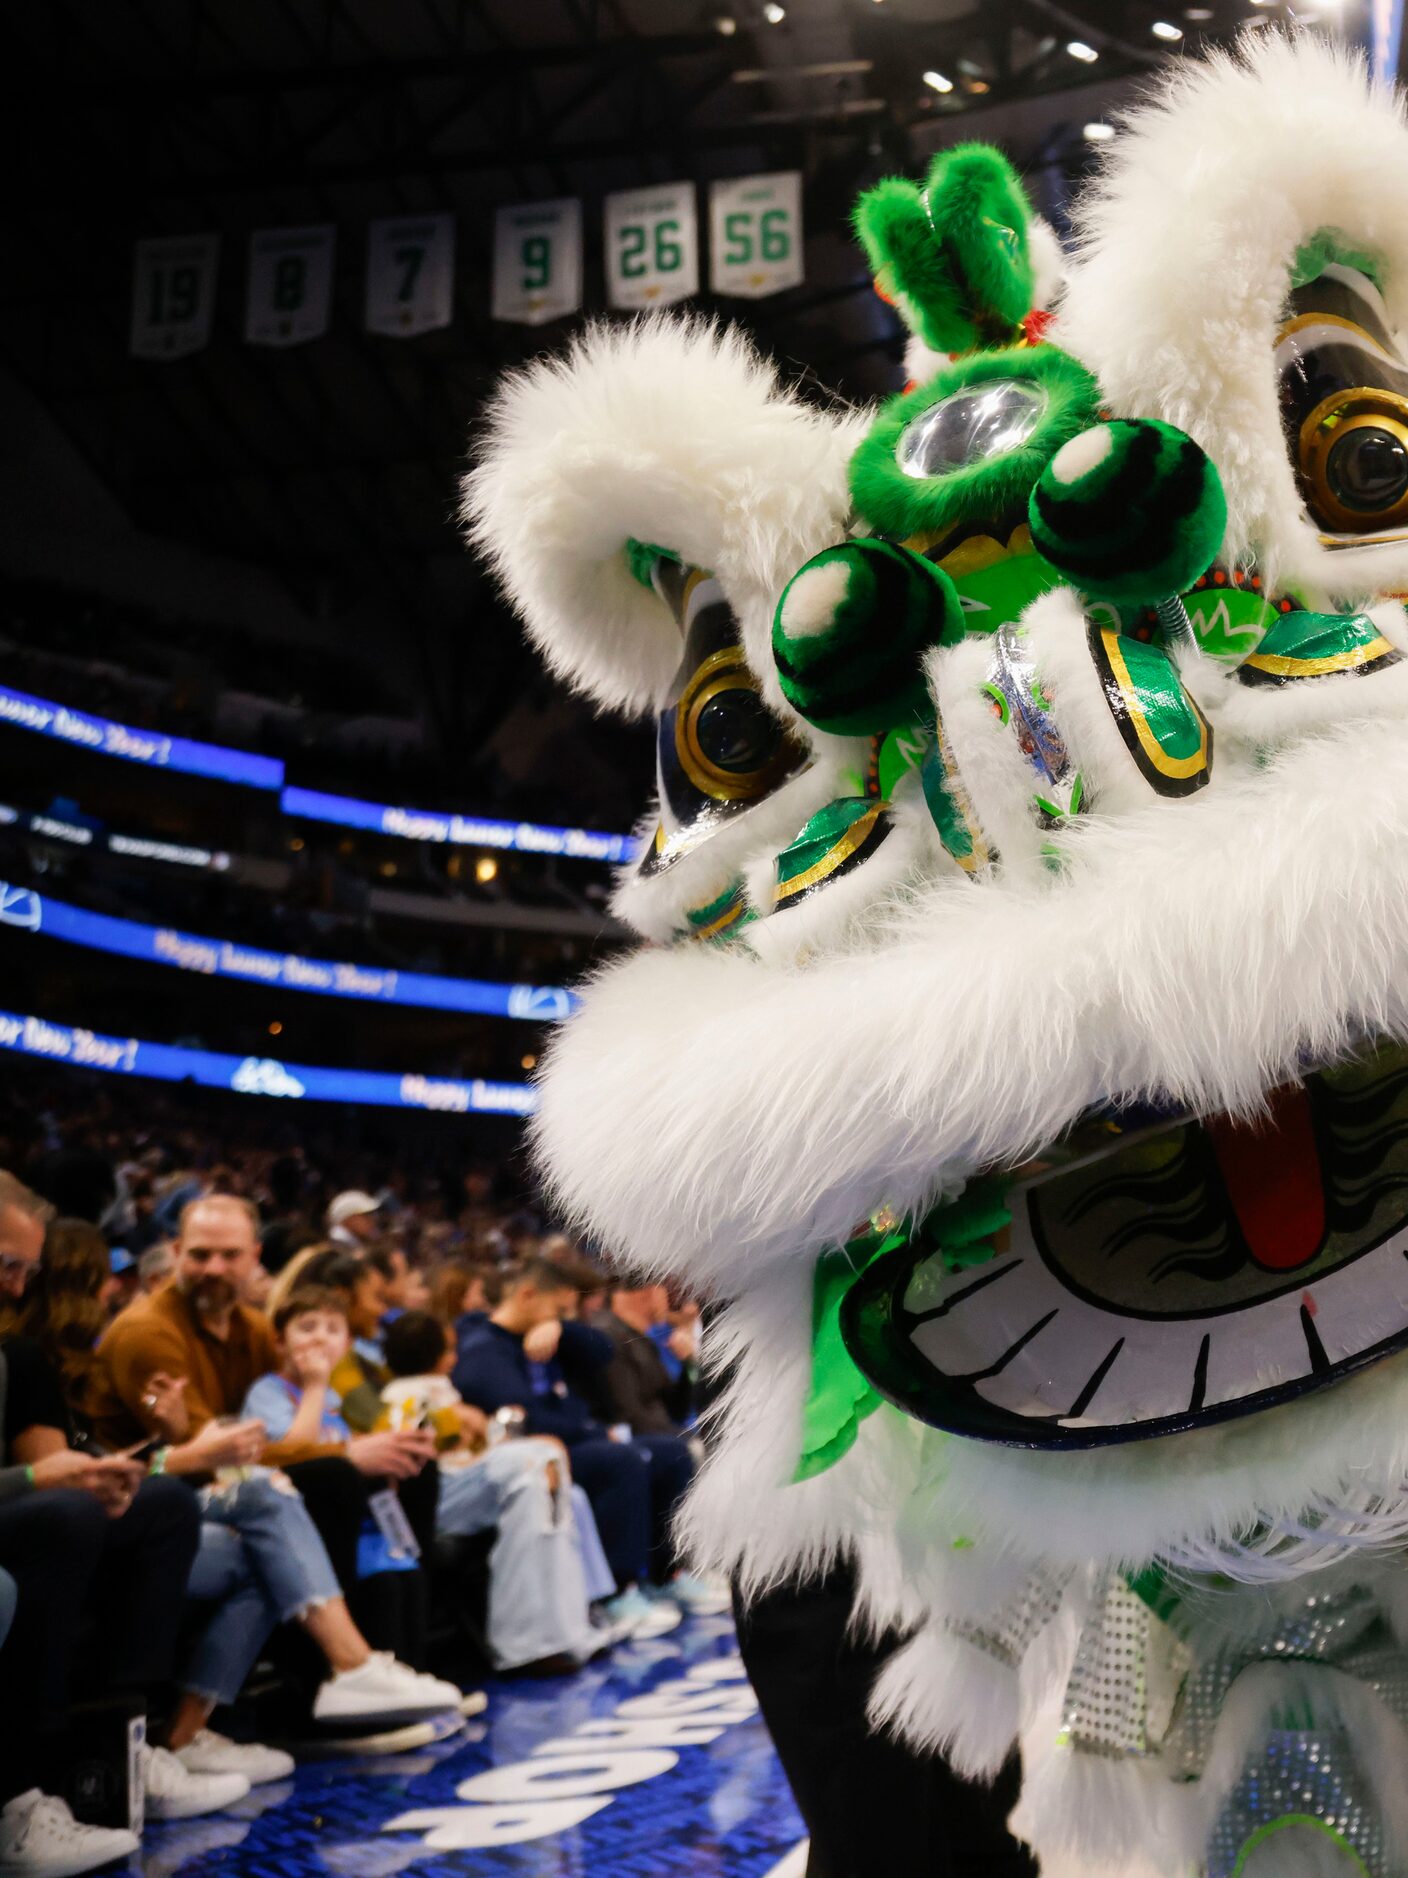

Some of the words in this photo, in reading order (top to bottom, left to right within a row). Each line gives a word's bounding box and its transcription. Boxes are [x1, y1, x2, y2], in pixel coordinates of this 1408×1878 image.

[522, 236, 551, 290] 9
[619, 219, 683, 279] 26
[725, 208, 791, 266] 56
[395, 245, 424, 302] 7
[0, 695, 54, 731] unar
[54, 707, 104, 747] New
[381, 807, 449, 843] Happy
[449, 814, 514, 850] Lunar
[515, 822, 565, 855] New
[154, 929, 217, 975] Happy
[220, 941, 281, 981] Lunar
[282, 954, 333, 989] New
[23, 1016, 72, 1057] New
[399, 1073, 467, 1113] Happy
